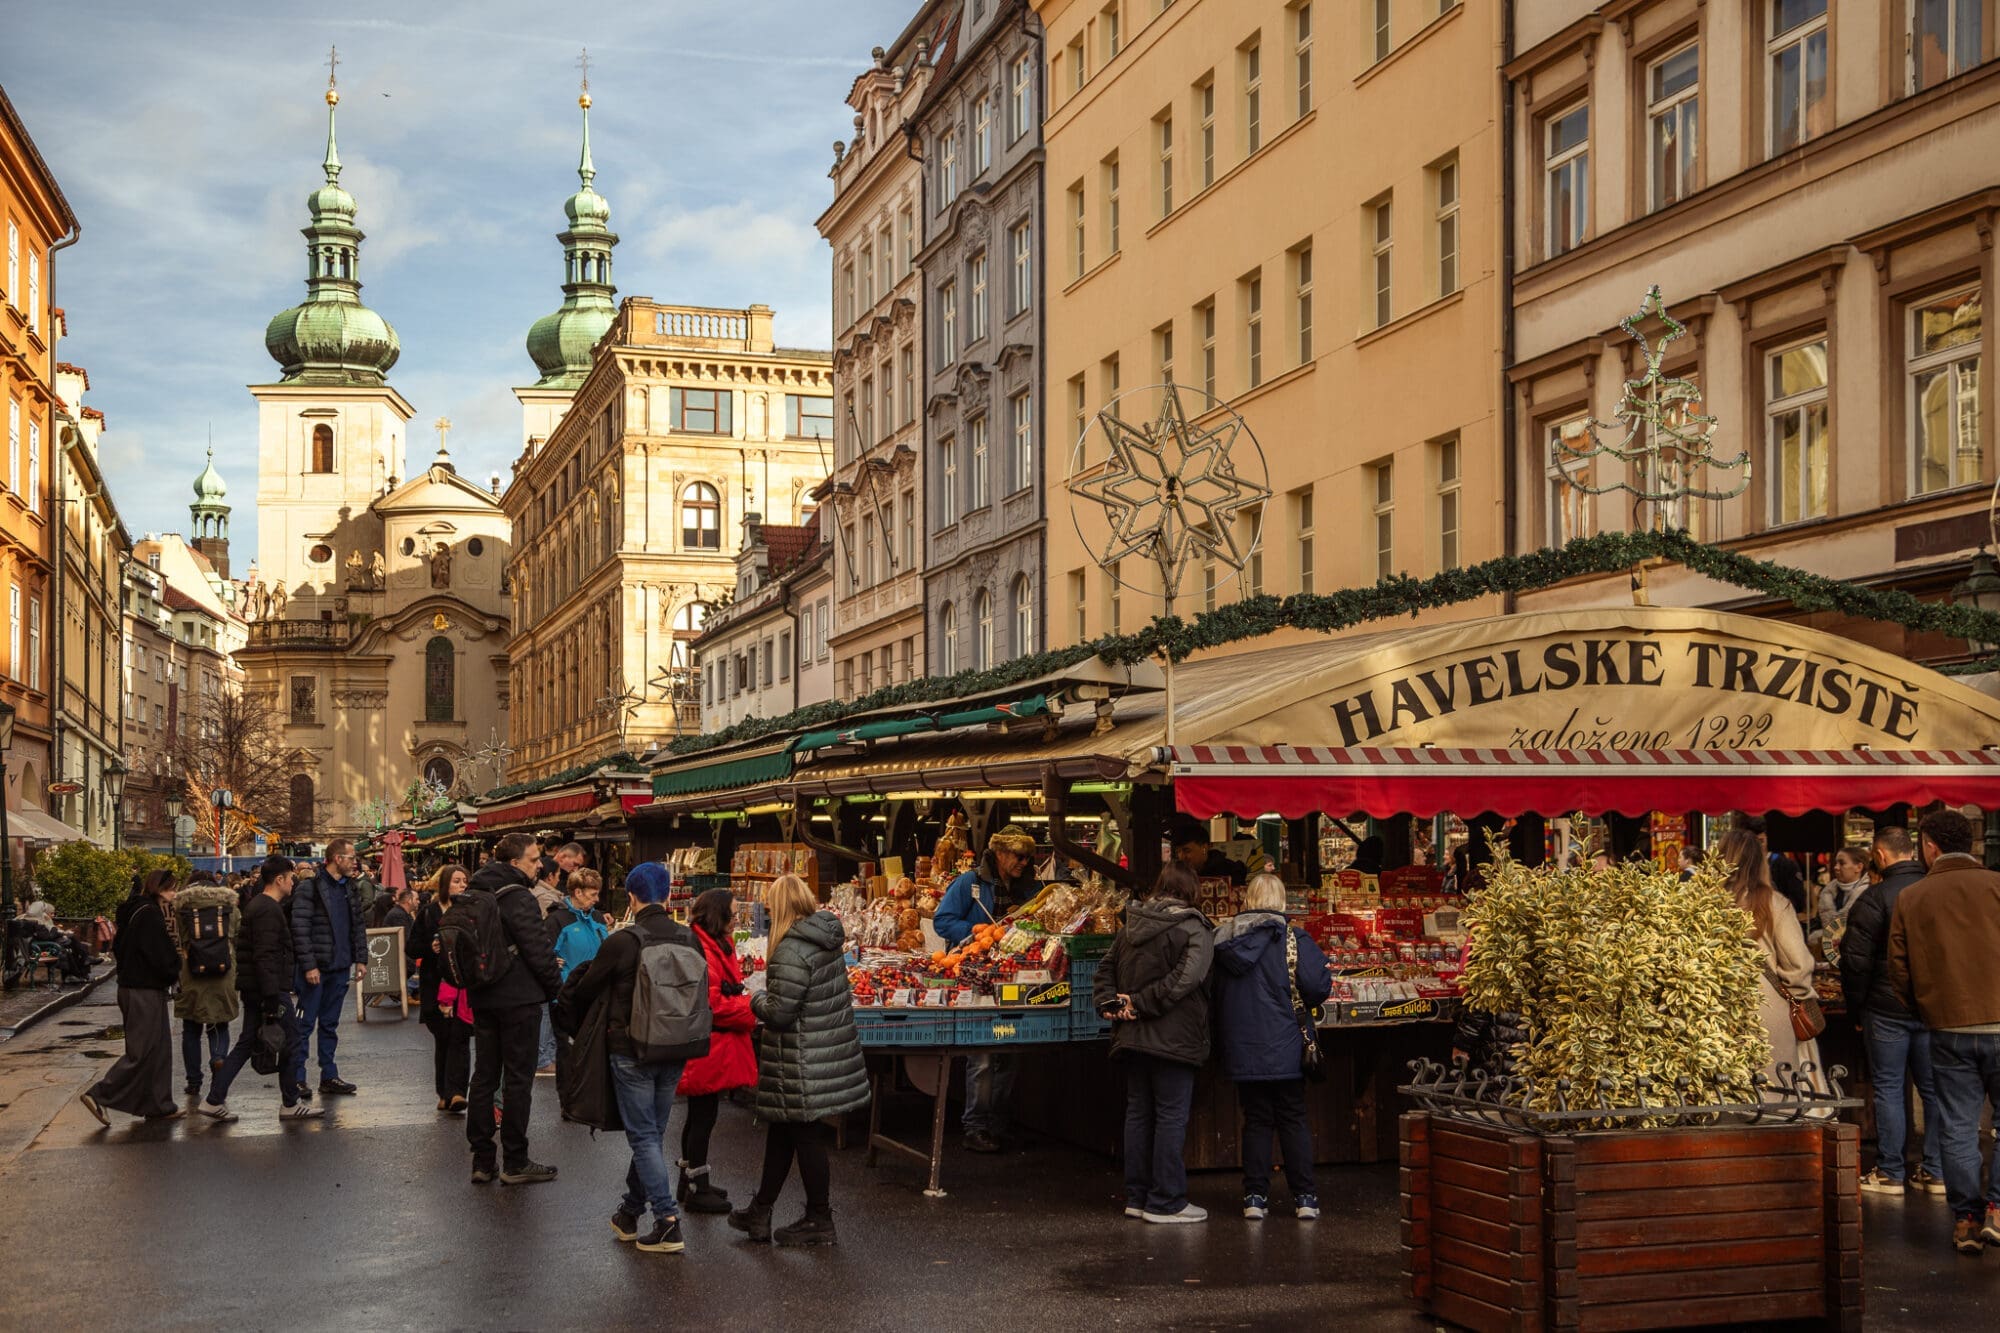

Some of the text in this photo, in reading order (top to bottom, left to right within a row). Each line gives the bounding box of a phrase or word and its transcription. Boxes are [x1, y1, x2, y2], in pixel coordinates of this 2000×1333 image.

[1330, 629, 1920, 747] HAVELSKÉ TRŽIŠTĚ
[1509, 707, 1773, 750] založeno 1232
